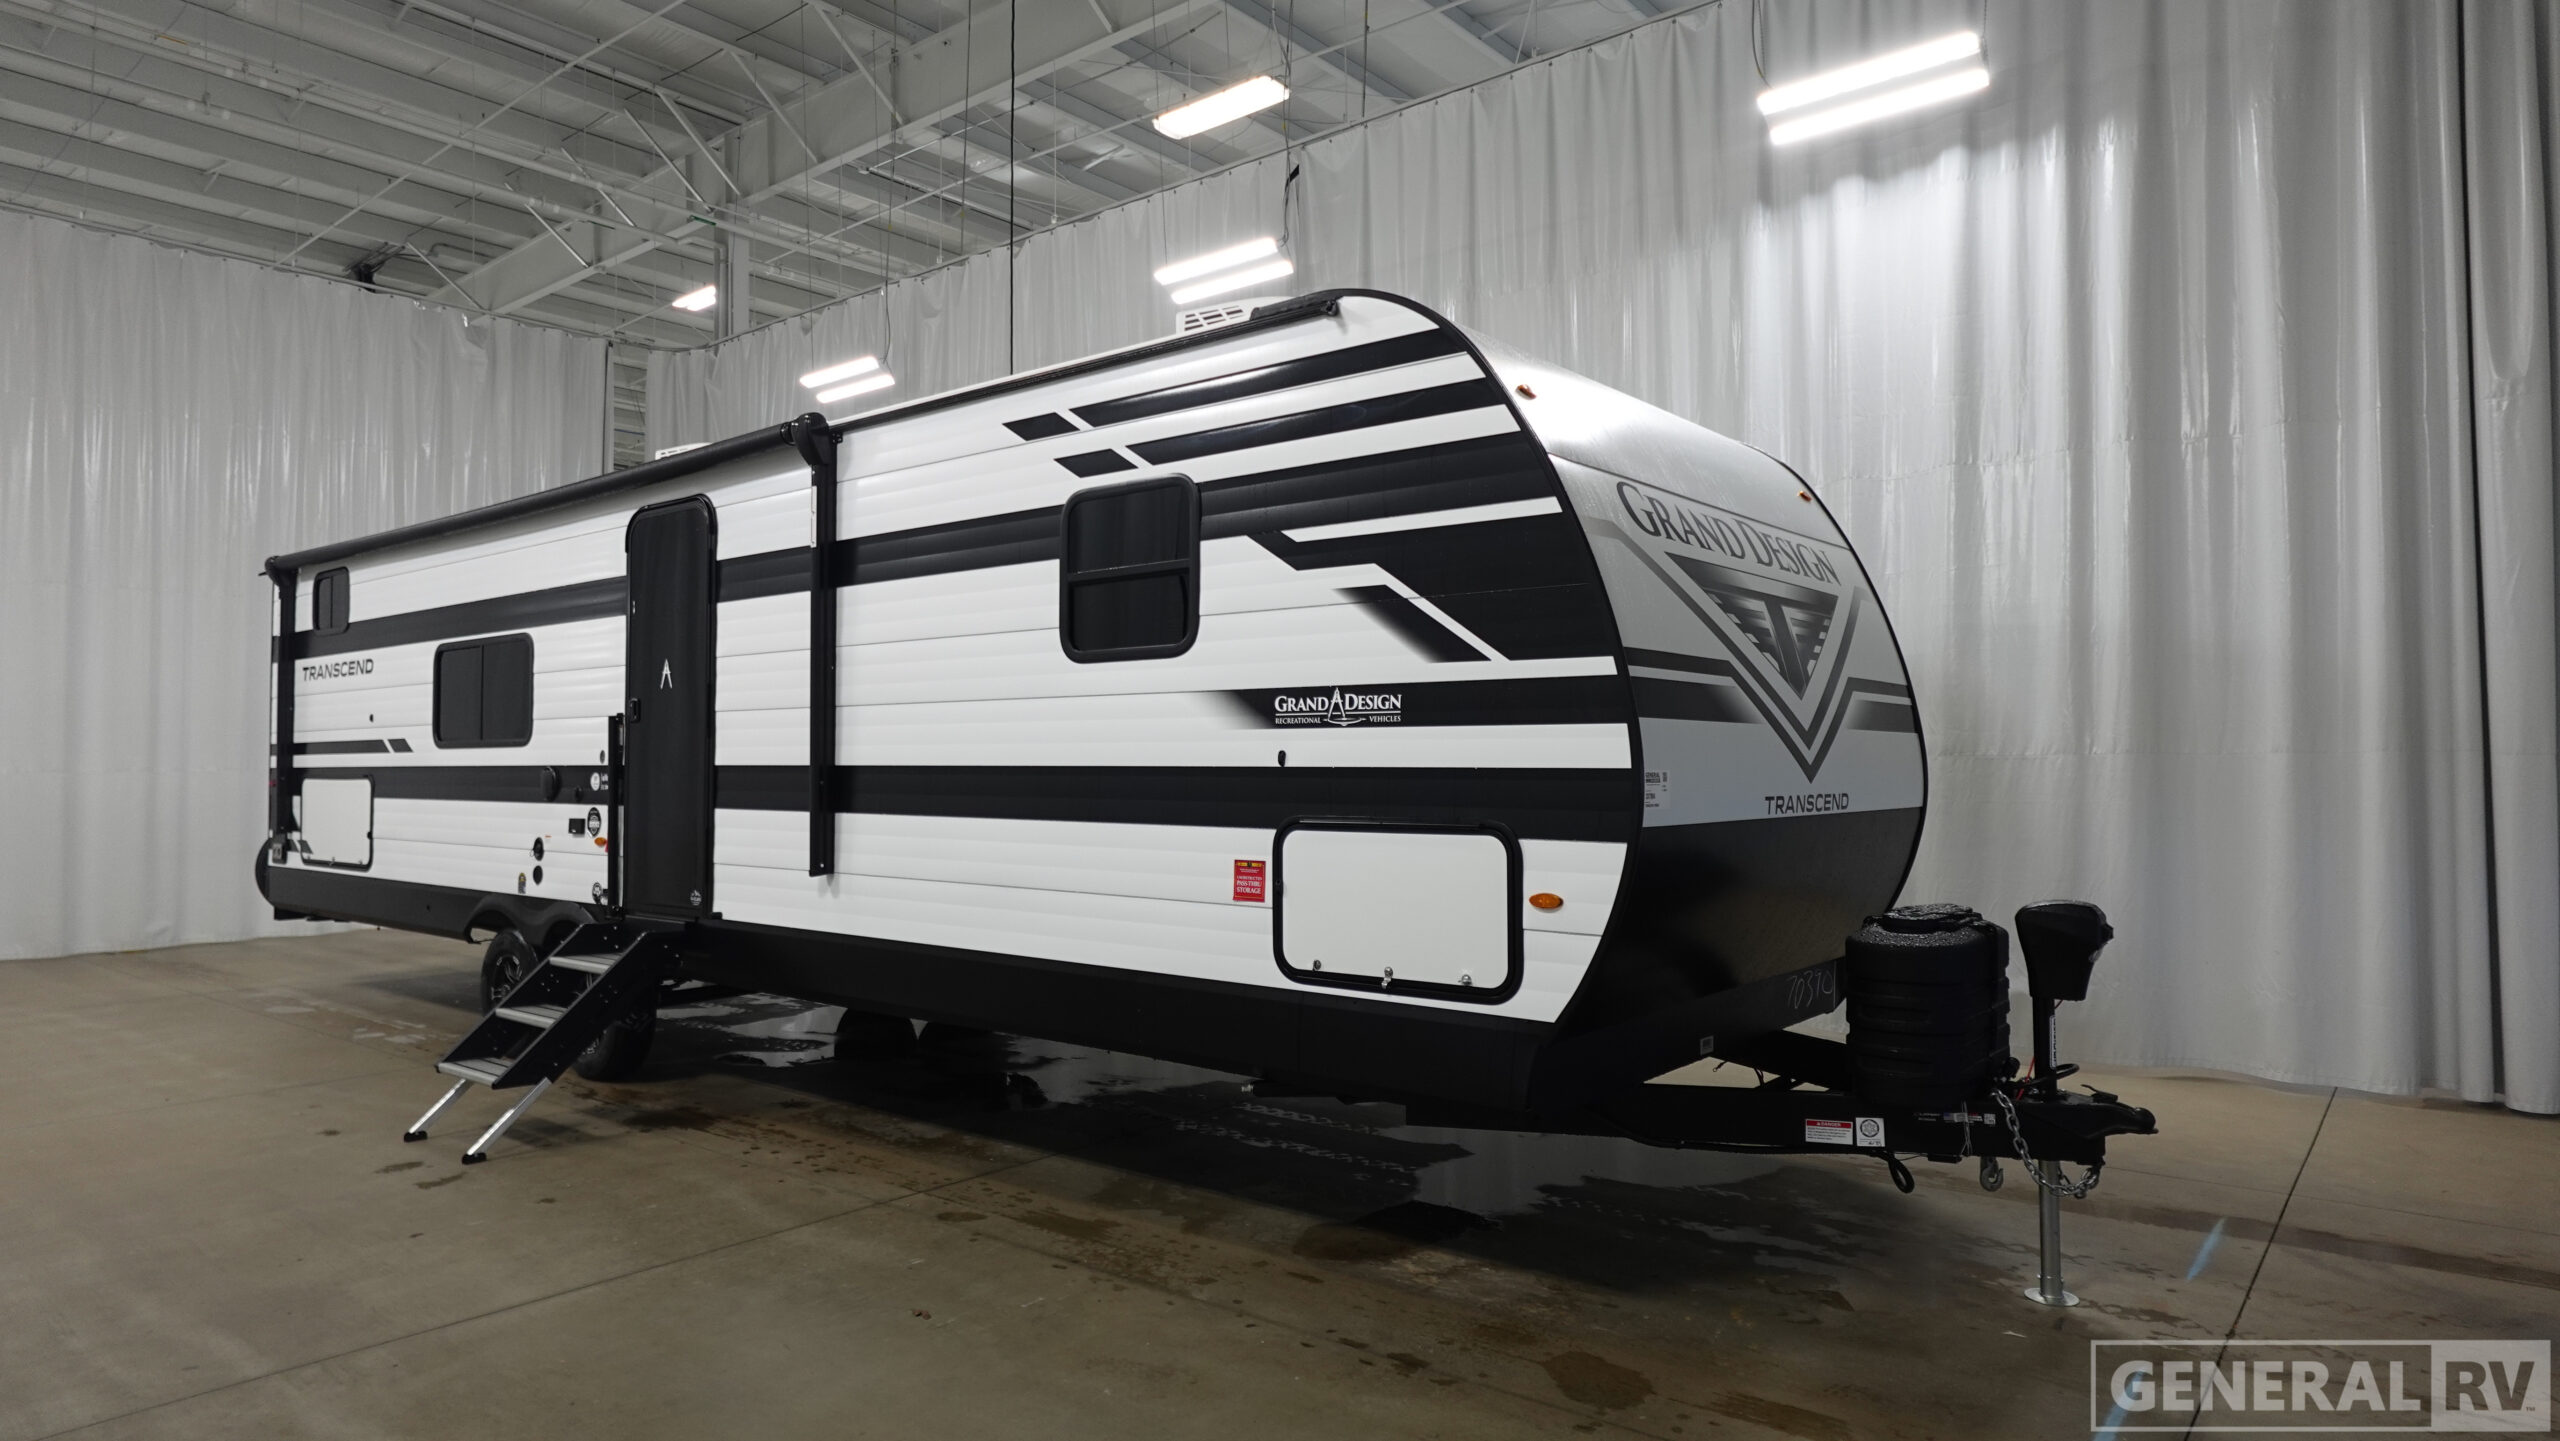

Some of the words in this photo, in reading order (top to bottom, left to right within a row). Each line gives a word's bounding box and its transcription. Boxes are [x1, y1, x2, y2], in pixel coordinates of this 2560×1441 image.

[1615, 481, 1746, 560] GRAND
[1731, 517, 1842, 587] DESIGN
[302, 658, 375, 682] TRANSCEND
[1274, 695, 1330, 713] GRAND
[1344, 693, 1402, 711] DESIGN
[1275, 716, 1322, 725] RECREATIONAL
[1368, 715, 1402, 723] VEHICLES
[1765, 792, 1849, 815] TRANSCEND
[1236, 886, 1262, 895] STORAGE
